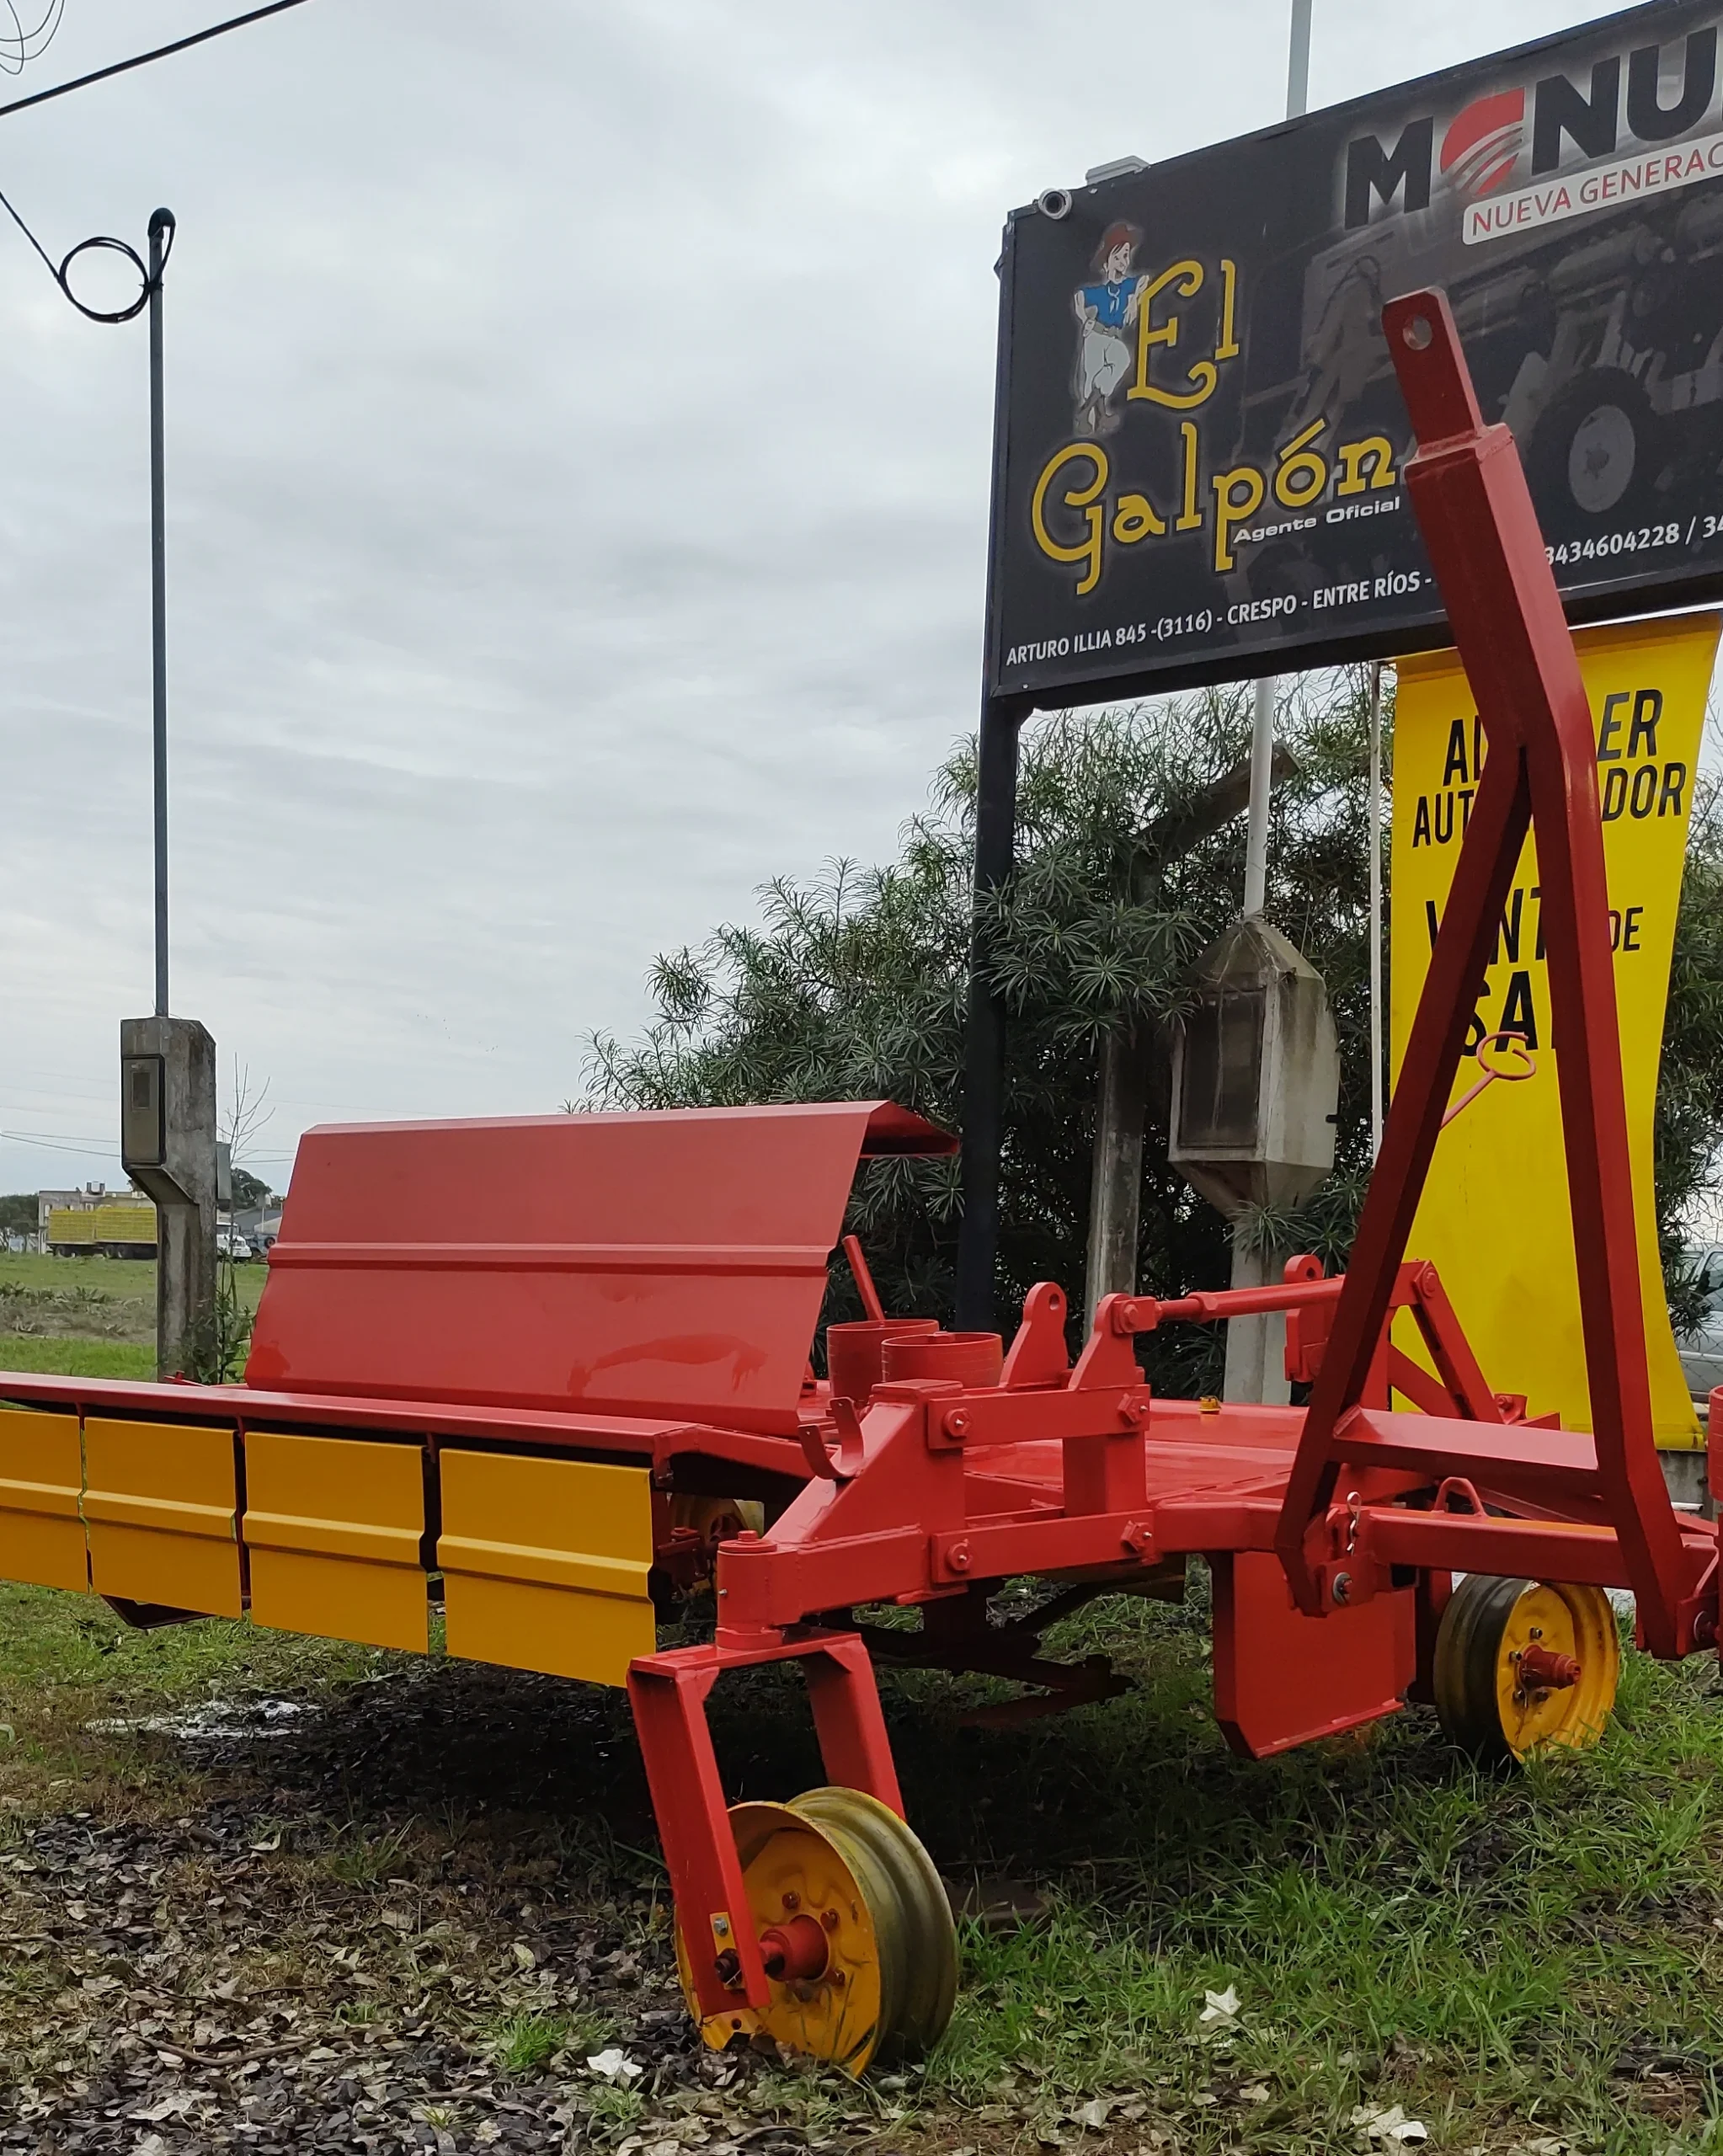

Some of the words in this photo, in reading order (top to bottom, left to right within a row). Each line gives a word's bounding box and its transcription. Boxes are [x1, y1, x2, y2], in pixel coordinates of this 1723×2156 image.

[1472, 187, 1571, 237] NUEVA
[1127, 259, 1239, 410] El
[1031, 419, 1395, 595] Galpón
[1233, 517, 1317, 543] Agente
[1326, 496, 1400, 524] Oficial
[1006, 637, 1070, 666] ARTURO
[1074, 629, 1112, 654] ILLIA
[1115, 623, 1146, 646] 845
[1227, 595, 1297, 625] CRESPO
[1313, 580, 1370, 610] ENTRE
[1374, 570, 1421, 599] RÍOS
